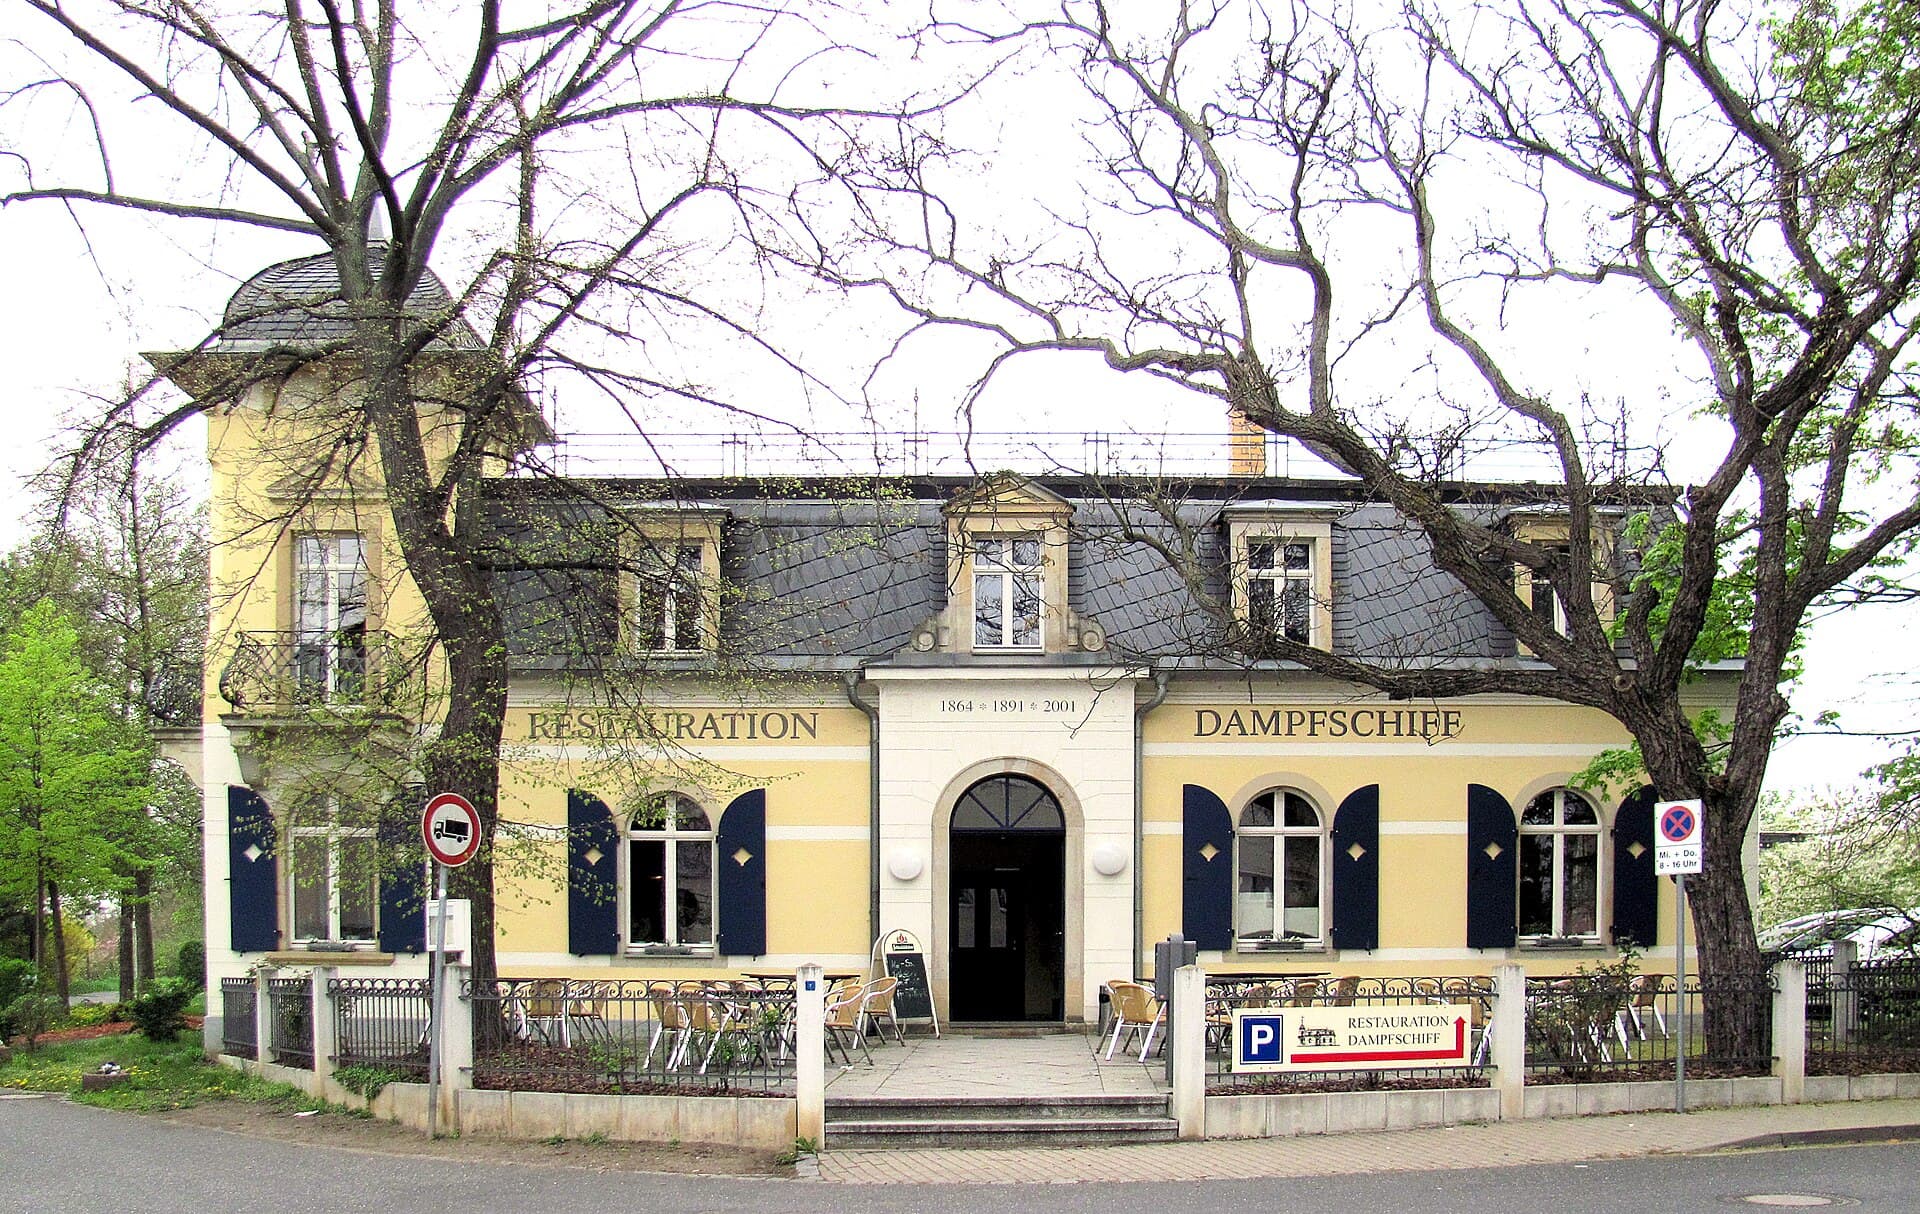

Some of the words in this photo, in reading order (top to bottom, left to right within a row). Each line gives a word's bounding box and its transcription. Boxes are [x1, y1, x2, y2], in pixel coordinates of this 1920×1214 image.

[940, 700, 973, 713] 1864
[993, 700, 1024, 713] 1891
[1043, 700, 1075, 713] 2001
[528, 712, 818, 740] RESTAURATION
[1194, 709, 1462, 737] DAMPFSCHIFF
[1683, 849, 1698, 857] Do.
[1683, 860, 1697, 868] Uhr
[1348, 1015, 1449, 1029] RESTAURATION
[1251, 1025, 1274, 1055] P
[1348, 1032, 1441, 1046] DAMPFSCHIFF
